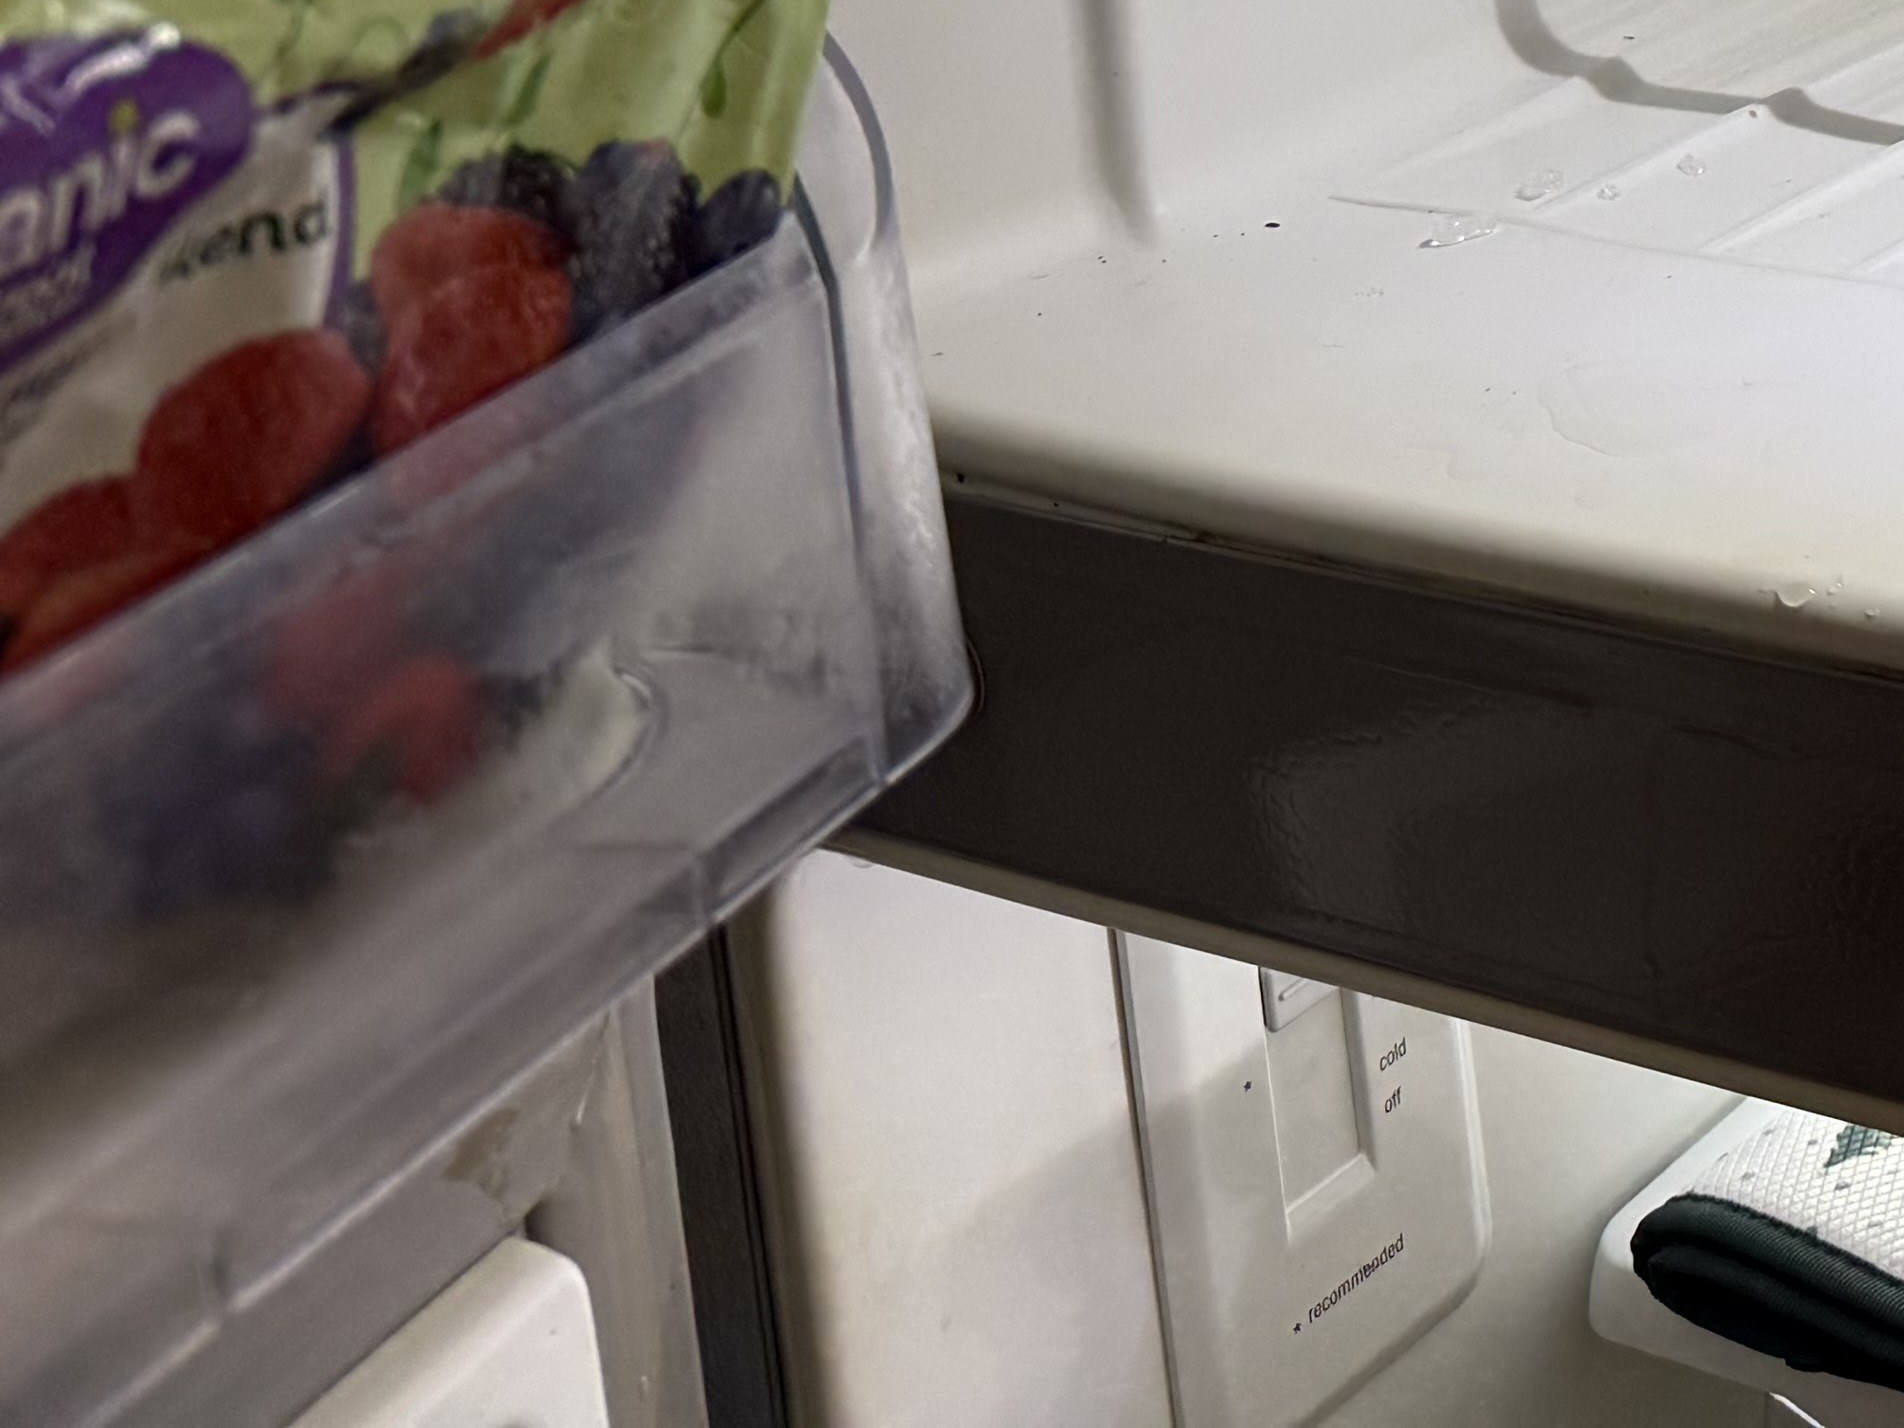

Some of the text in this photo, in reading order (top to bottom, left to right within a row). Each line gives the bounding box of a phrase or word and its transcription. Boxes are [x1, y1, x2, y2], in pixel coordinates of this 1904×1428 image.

[1379, 1036, 1407, 1072] cold
[1384, 1085, 1402, 1114] off
[1308, 1232, 1404, 1324] recommended
